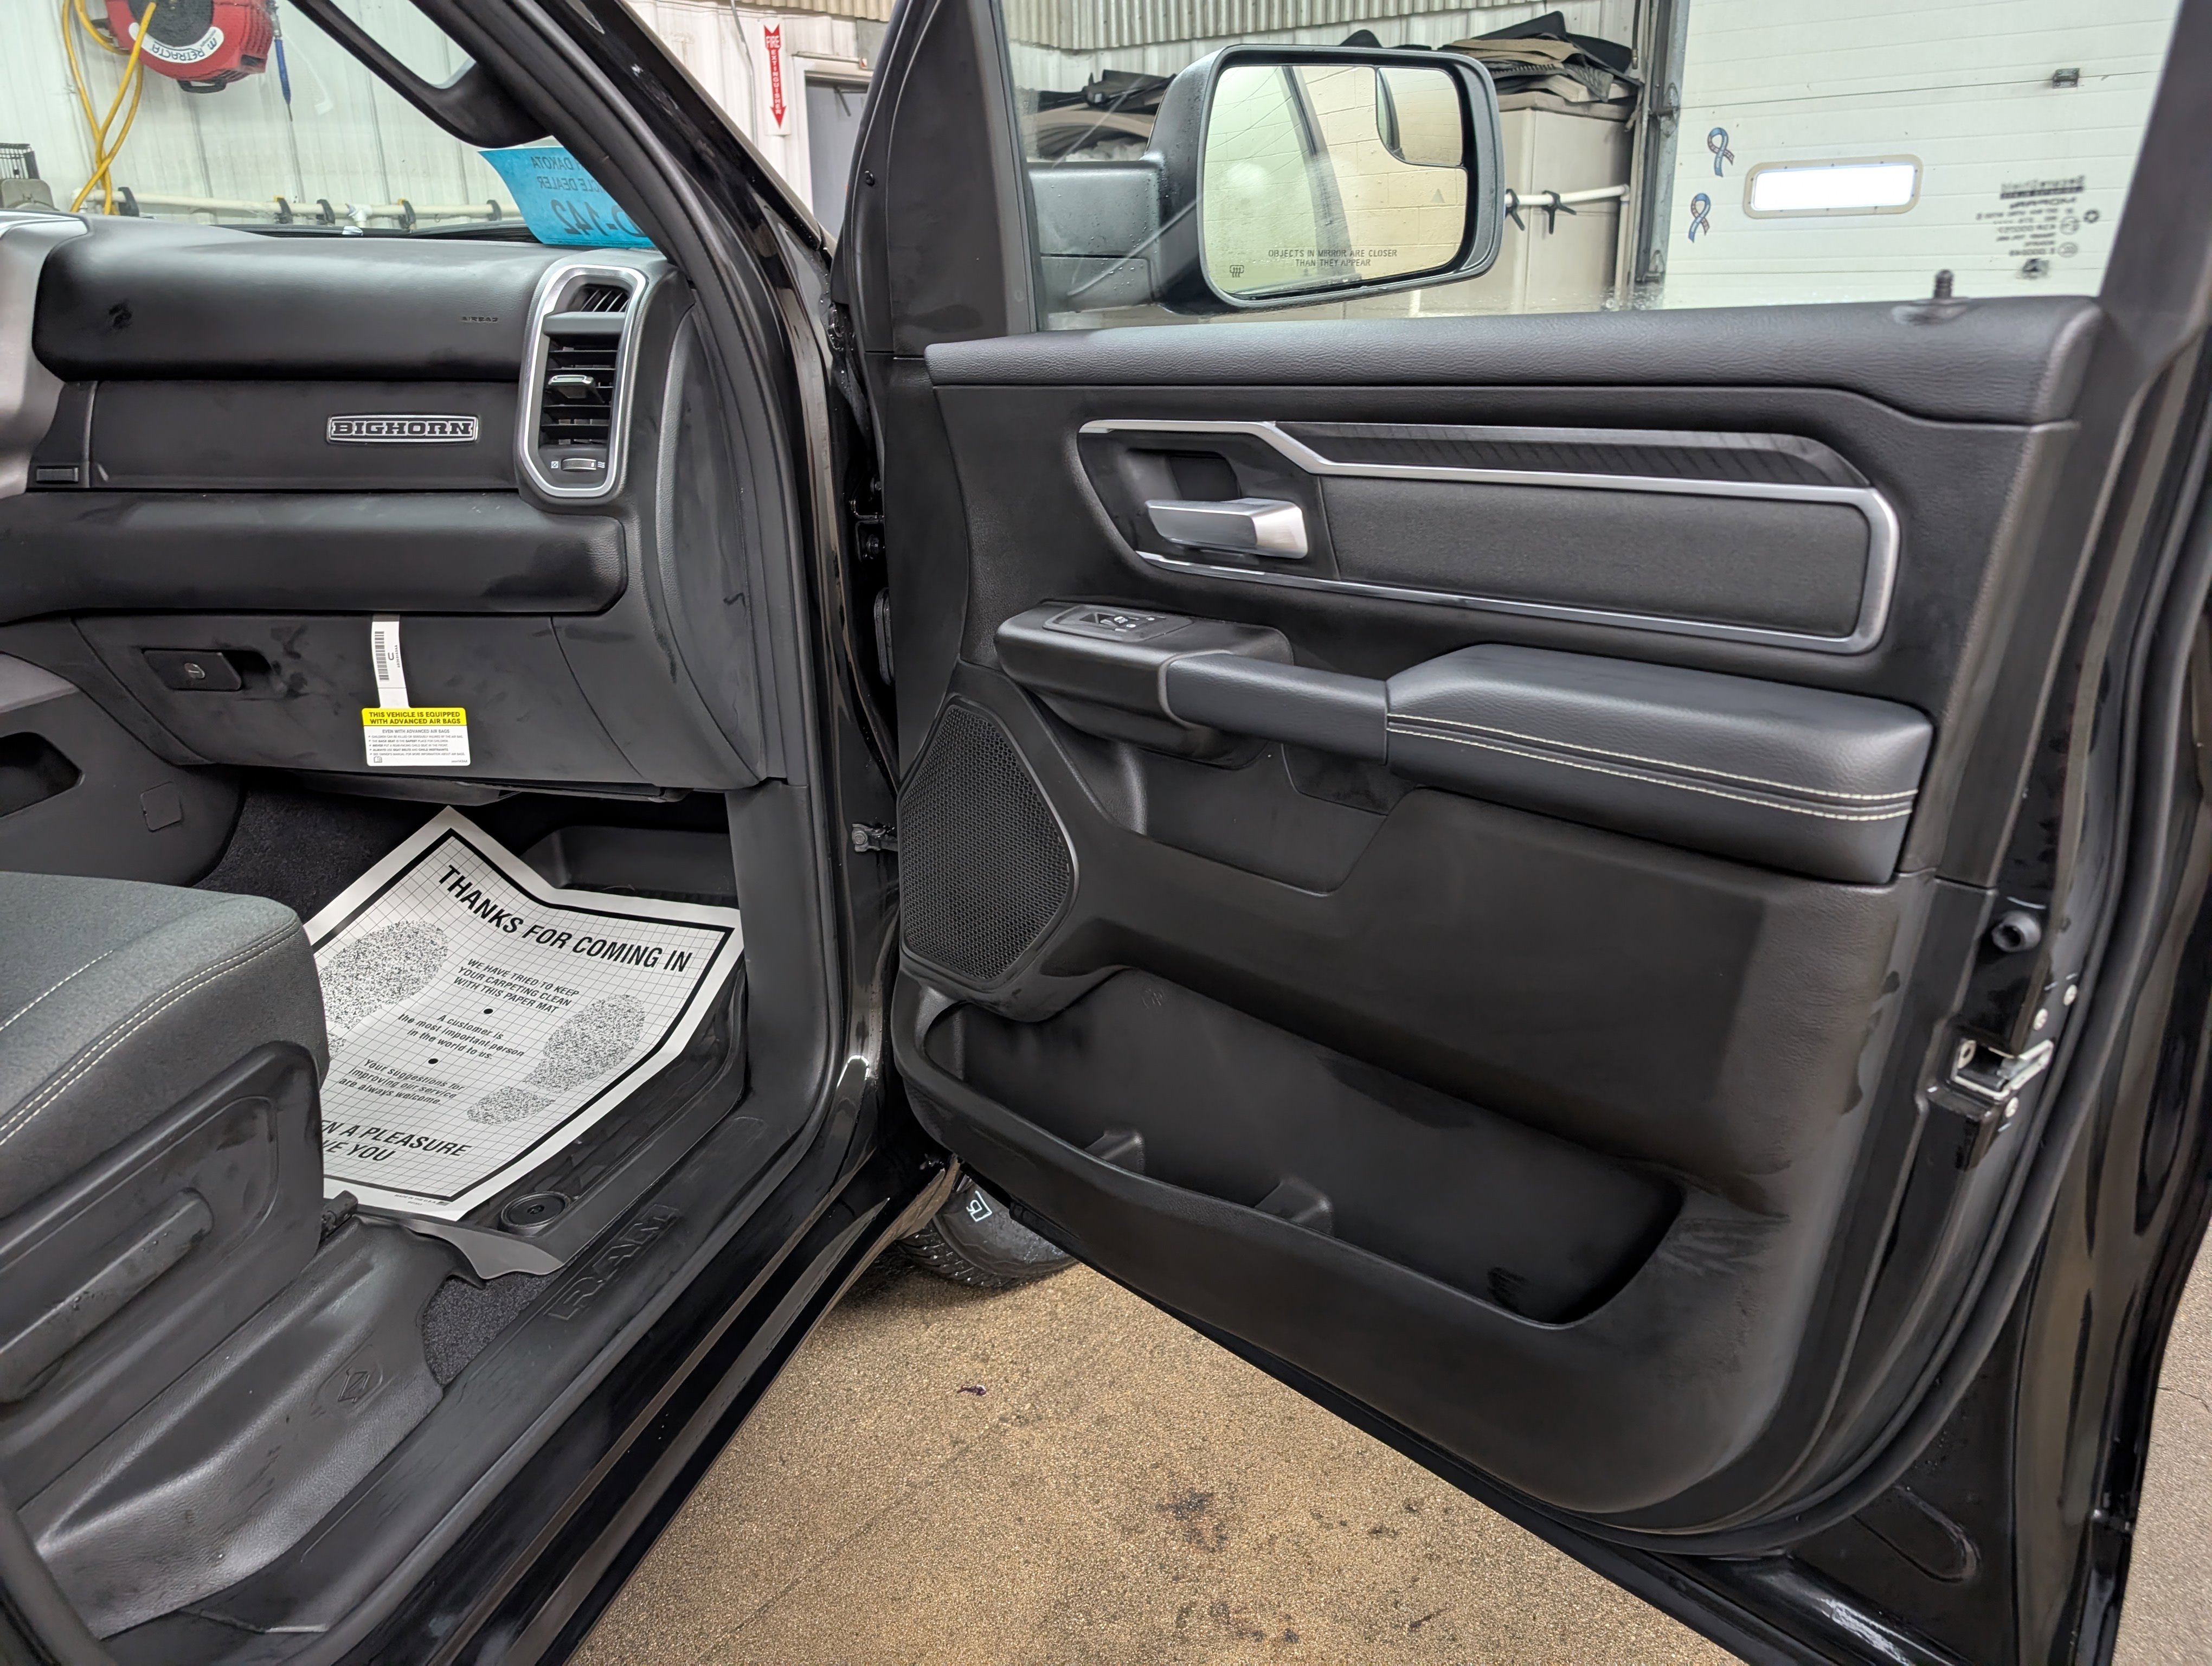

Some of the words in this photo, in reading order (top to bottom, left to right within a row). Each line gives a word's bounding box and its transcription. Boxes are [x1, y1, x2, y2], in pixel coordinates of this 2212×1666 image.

[152, 43, 205, 61] RETRACTA
[766, 35, 780, 48] FIRE
[770, 49, 782, 115] EXTINGUISHER
[1296, 259, 1316, 267] THAN
[1320, 259, 1338, 267] THEY
[1368, 249, 1397, 257] CLOSER
[331, 420, 474, 436] BIGHORN
[438, 864, 524, 933] THANKS
[521, 925, 573, 949] FOR
[572, 937, 663, 967] COMING
[664, 950, 693, 972] IN
[458, 966, 485, 981] YOUR
[486, 976, 539, 997] CARPETING
[539, 992, 572, 1007] CLEAN
[467, 958, 485, 969] WE
[483, 965, 510, 977] HAVE
[511, 972, 539, 986] TRIED
[540, 981, 554, 990] TO
[554, 985, 580, 997] KEEP
[453, 977, 480, 990] WITH
[480, 985, 504, 998] THIS
[504, 992, 536, 1007] PAPER
[536, 1002, 559, 1014] MAT
[398, 1014, 415, 1024] the
[415, 1020, 442, 1031] most
[442, 1027, 490, 1047] important
[489, 1043, 525, 1057] person
[407, 1028, 418, 1036] in
[419, 1032, 436, 1042] the
[437, 1039, 467, 1052] world
[467, 1047, 478, 1055] to
[478, 1052, 492, 1060] us.
[447, 1018, 493, 1035] customer
[492, 1031, 504, 1040] is
[349, 1067, 400, 1088] improving
[419, 1085, 457, 1099] service
[363, 1059, 388, 1072] Your
[388, 1068, 448, 1087] suggestions
[448, 1082, 465, 1091] for
[338, 1078, 358, 1087] are
[358, 1084, 395, 1097] always
[395, 1091, 442, 1105] welcome.
[339, 1125, 361, 1137] A
[358, 1127, 472, 1156] PLEASURE
[346, 1144, 396, 1161] YOU
